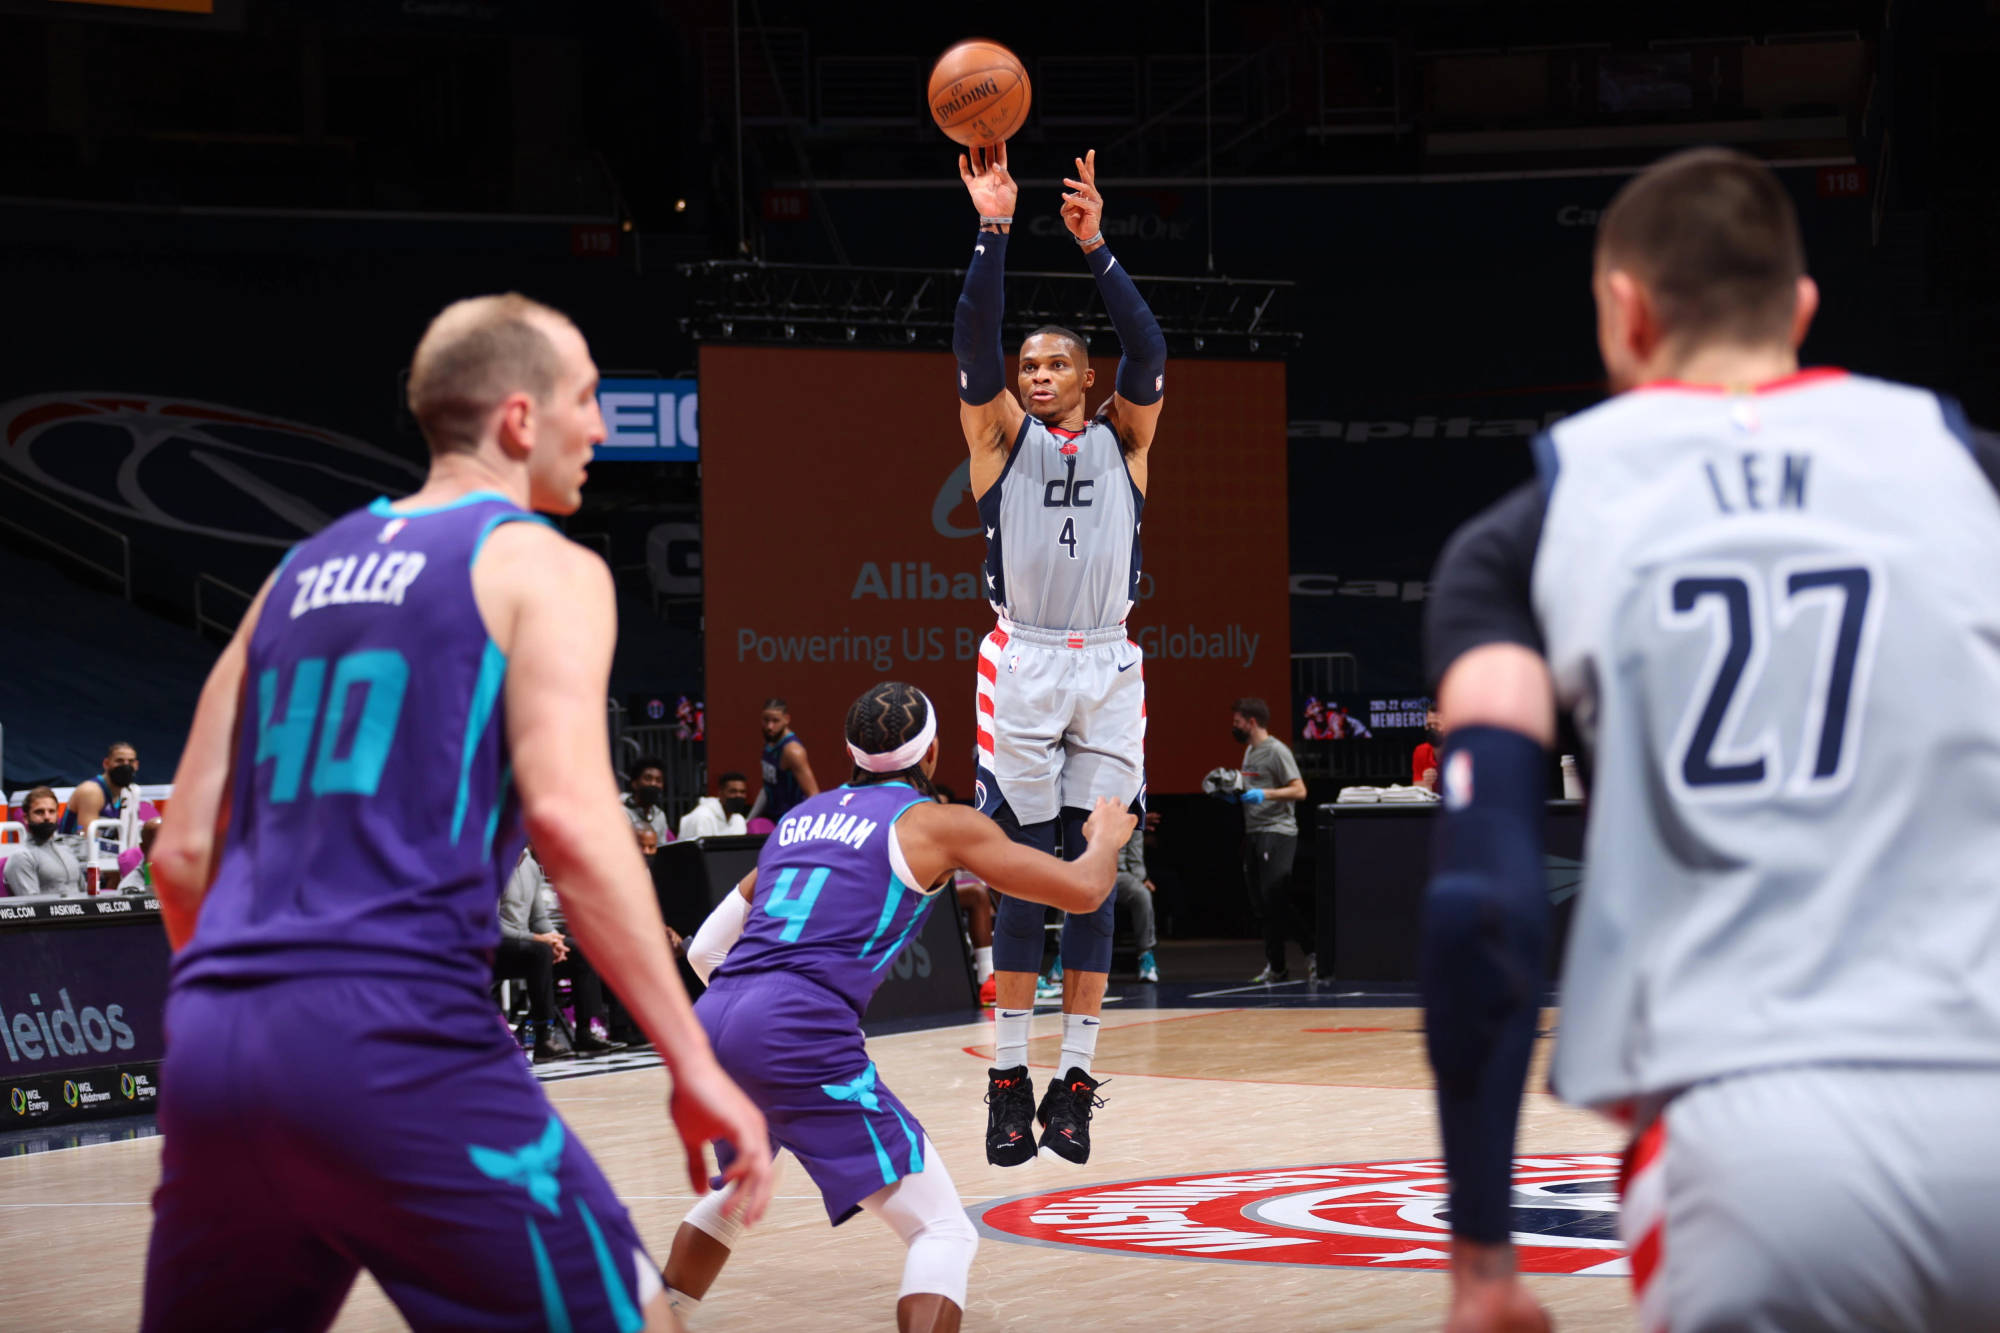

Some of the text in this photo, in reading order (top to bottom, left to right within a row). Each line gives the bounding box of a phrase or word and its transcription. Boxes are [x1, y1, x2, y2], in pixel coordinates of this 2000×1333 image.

[935, 78, 999, 122] SPALDING
[1824, 171, 1859, 194] 118
[1704, 453, 1812, 515] LEN
[1057, 516, 1078, 560] 4
[290, 551, 427, 620] ZELLER
[851, 562, 988, 600] Aliba
[737, 629, 893, 671] Powering
[902, 629, 939, 662] US
[1142, 625, 1260, 668] Globally
[1668, 562, 1876, 794] 27
[255, 648, 410, 804] 40
[778, 812, 878, 850] GRAHAM
[50, 904, 85, 916] #ASKWGL
[96, 901, 132, 913] WGL.COM
[763, 866, 832, 943] 4
[0, 987, 136, 1063] leidos
[26, 1090, 41, 1099] WGL
[78, 1082, 93, 1092] WGL
[135, 1075, 149, 1085] WGL
[136, 1086, 156, 1096] Energy
[28, 1101, 49, 1111] Energy
